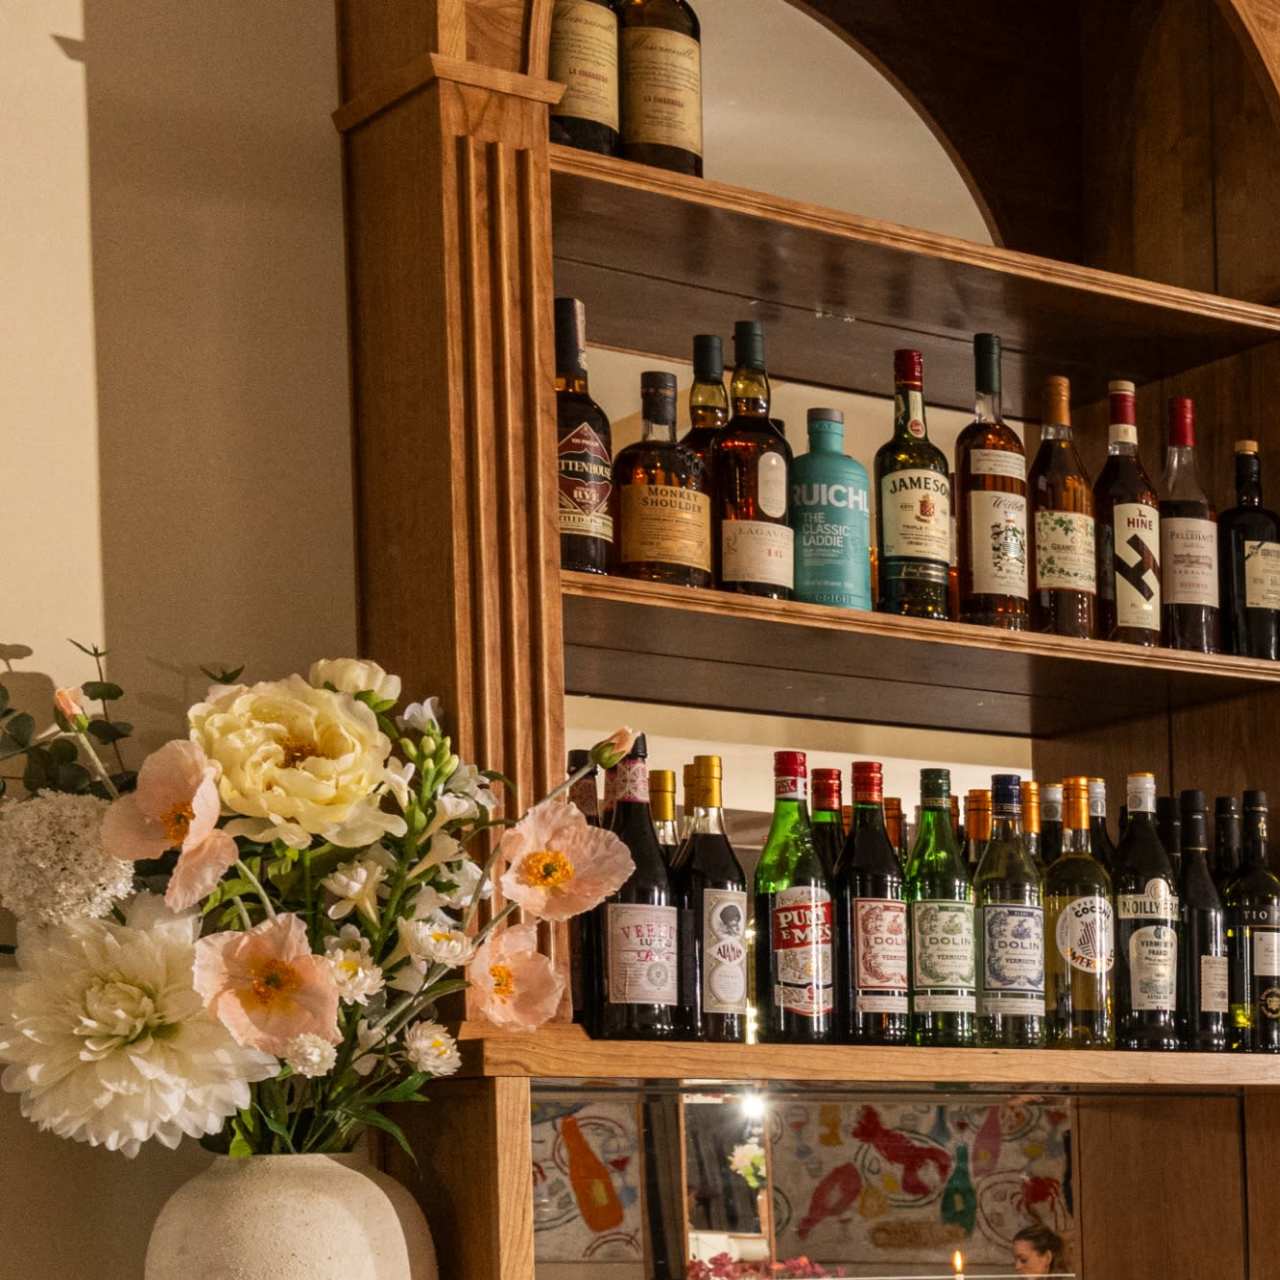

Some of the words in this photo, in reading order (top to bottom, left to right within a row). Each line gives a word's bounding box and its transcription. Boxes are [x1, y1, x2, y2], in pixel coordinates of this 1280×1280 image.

[802, 512, 825, 524] THE
[802, 523, 850, 537] CLASSIC
[1127, 518, 1153, 531] HINE
[802, 535, 844, 547] LADDIE
[929, 936, 971, 946] DOLIN
[998, 940, 1039, 951] DOLIN
